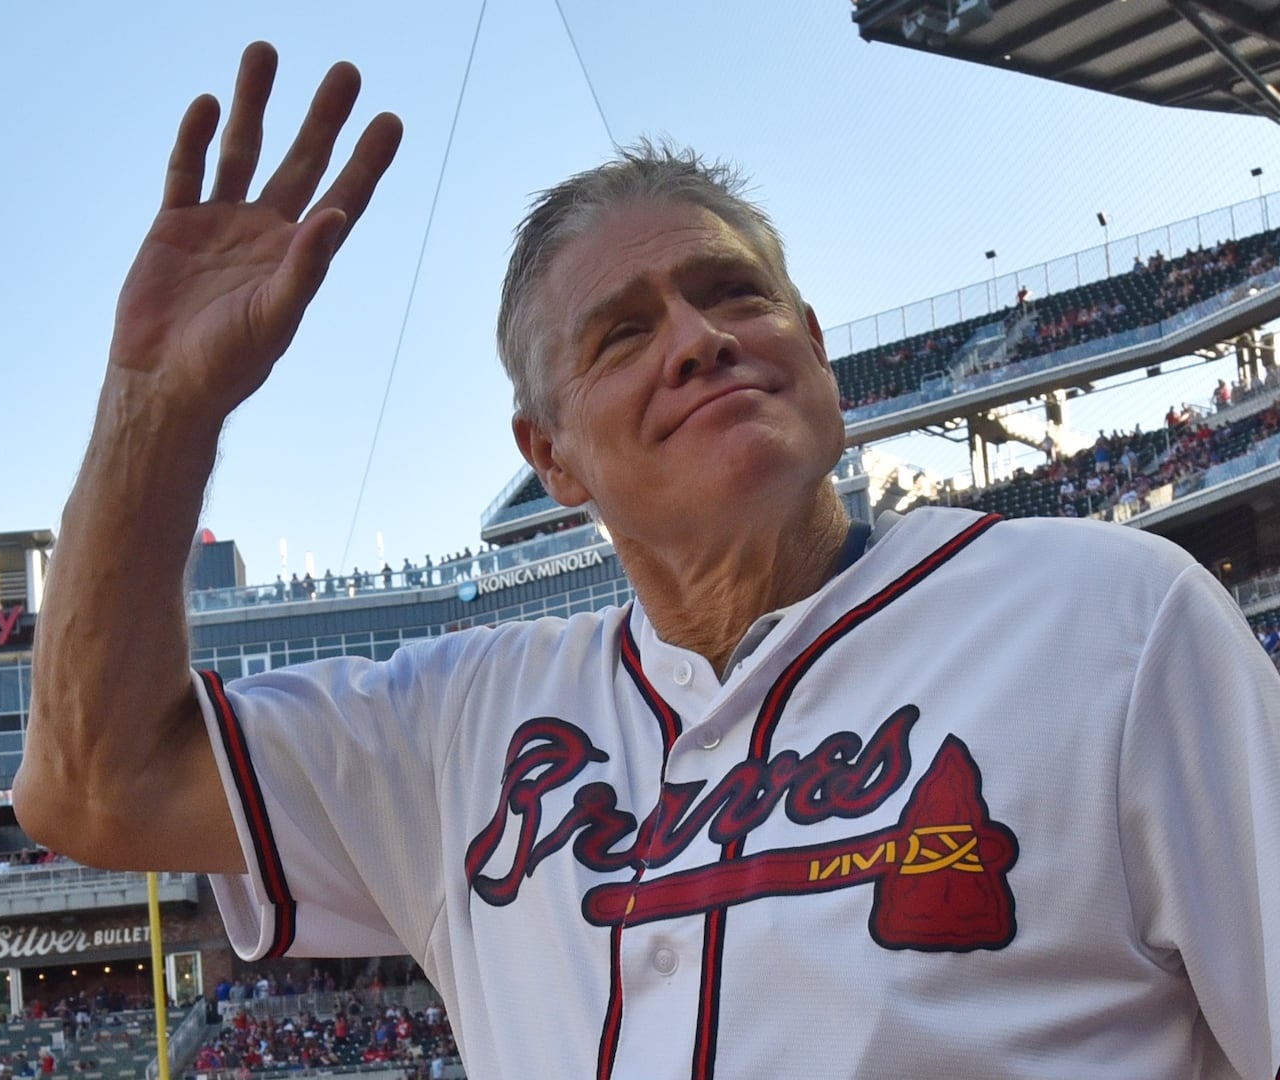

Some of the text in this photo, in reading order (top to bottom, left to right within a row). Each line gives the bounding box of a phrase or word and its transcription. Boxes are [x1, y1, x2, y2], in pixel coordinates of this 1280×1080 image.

[478, 551, 603, 596] KONICA MINOLTA
[465, 704, 921, 907] Braves
[93, 926, 151, 946] BULLET
